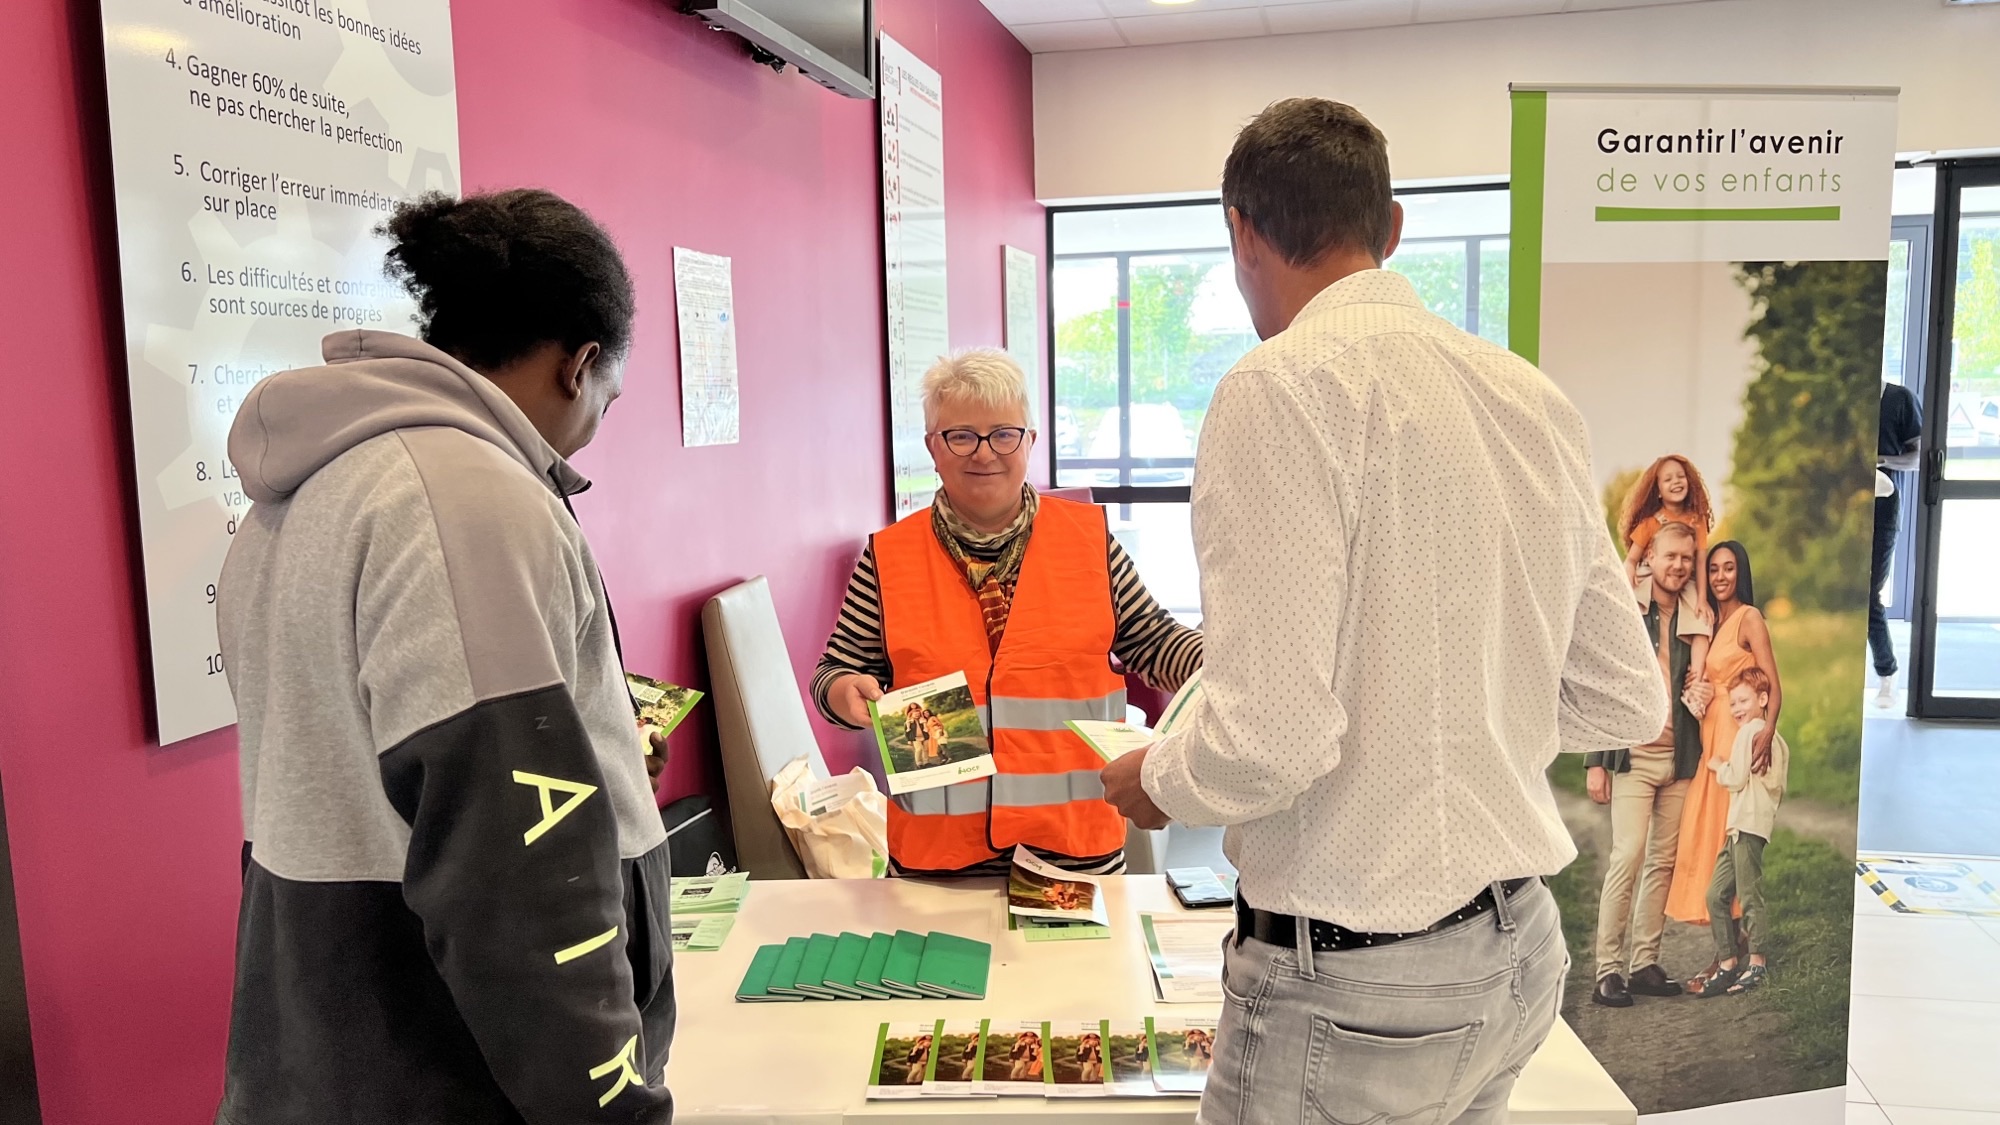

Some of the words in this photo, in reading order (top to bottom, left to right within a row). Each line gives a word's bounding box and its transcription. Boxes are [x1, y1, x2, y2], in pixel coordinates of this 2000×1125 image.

[183, 0, 301, 40] amélioration
[313, 0, 333, 24] les
[338, 8, 386, 43] bonnes
[390, 28, 422, 55] idées
[165, 48, 182, 70] 4.
[187, 55, 248, 88] Gagner
[253, 73, 285, 99] 60%
[290, 82, 308, 104] de
[312, 92, 350, 118] suite,
[190, 89, 211, 109] ne
[217, 95, 244, 116] pas
[250, 100, 315, 133] chercher
[320, 116, 332, 137] la
[336, 125, 403, 154] perfection
[1597, 128, 1725, 154] Garantir
[1731, 128, 1844, 154] l’avenir
[173, 154, 190, 176] 5.
[200, 161, 267, 193] Corriger
[271, 172, 326, 201] l’erreur
[330, 185, 399, 213] immédiate
[1596, 167, 1637, 192] de
[1654, 173, 1705, 192] vos
[1721, 167, 1841, 192] enfants
[204, 195, 230, 213] sur
[235, 196, 277, 220] place
[181, 261, 197, 283] 6.
[207, 264, 235, 286] Les
[239, 266, 314, 292] difficultés
[317, 276, 331, 294] et
[209, 296, 246, 315] sont
[250, 299, 309, 318] sources
[311, 300, 329, 319] de
[333, 304, 382, 325] progrès
[188, 364, 204, 384] 7.
[216, 395, 234, 414] et
[196, 461, 211, 481] 8.
